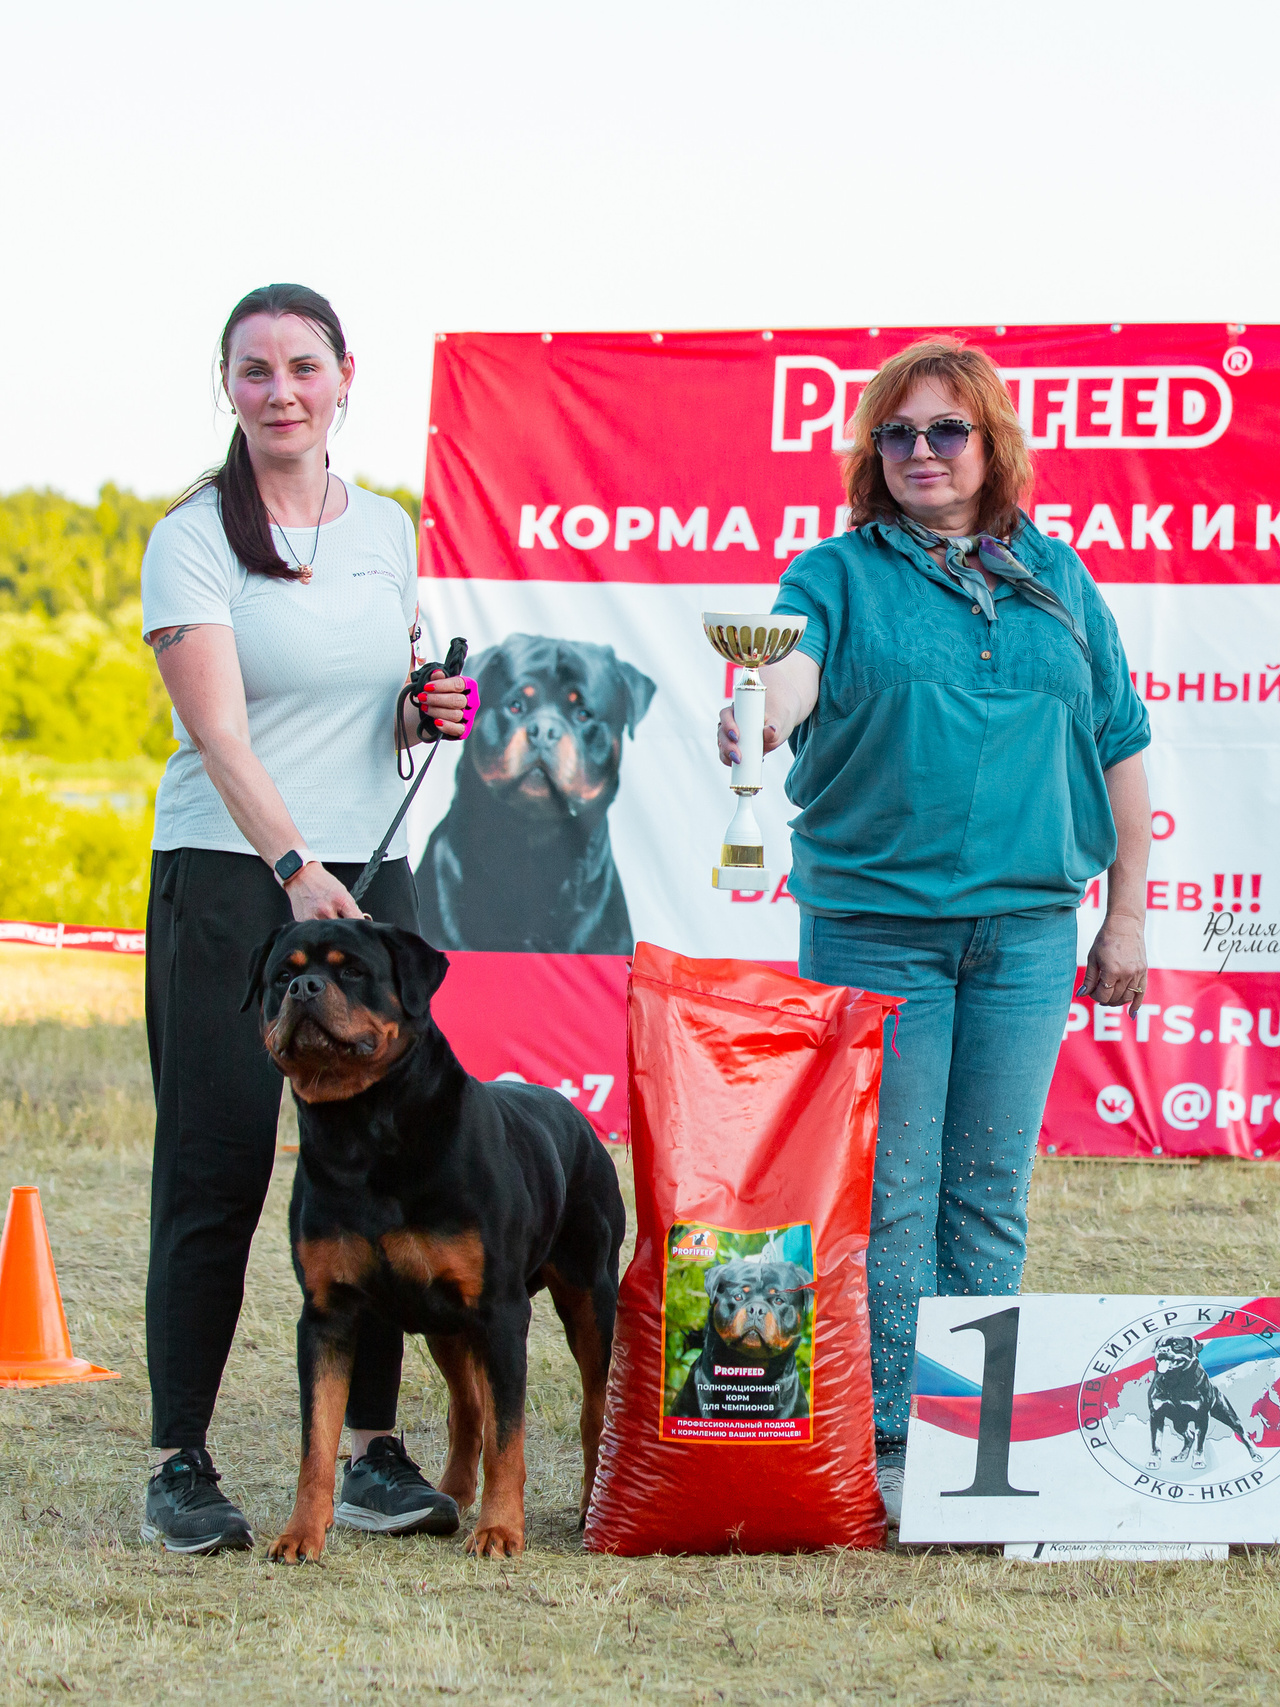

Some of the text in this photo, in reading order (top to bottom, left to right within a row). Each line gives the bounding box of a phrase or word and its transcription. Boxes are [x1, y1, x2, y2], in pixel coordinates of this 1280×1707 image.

[518, 504, 759, 552] КОРМА
[1033, 503, 1174, 551] БАК
[1192, 503, 1235, 551] И
[672, 1246, 715, 1256] PROFIFEED
[714, 1364, 765, 1377] PROFIFEED
[1082, 1311, 1178, 1449] РОТВЕЙЛЕР
[1197, 1308, 1278, 1340] КЛУБ
[697, 1383, 780, 1392] ПОЛНОРАЦИОННЫЙ
[725, 1394, 750, 1402] КОРМ
[939, 1306, 1040, 1497] 1
[702, 1403, 775, 1412] ДЛЯ ЧЕМПИОНОВ
[677, 1420, 796, 1429] ПРОФЕССИОНАЛЬНЫЙ ПОДХОД
[677, 1429, 727, 1437] КОРМЛЕНИЮ
[1133, 1470, 1264, 1500] РКФ-НКПР
[1049, 1543, 1087, 1552] Корма
